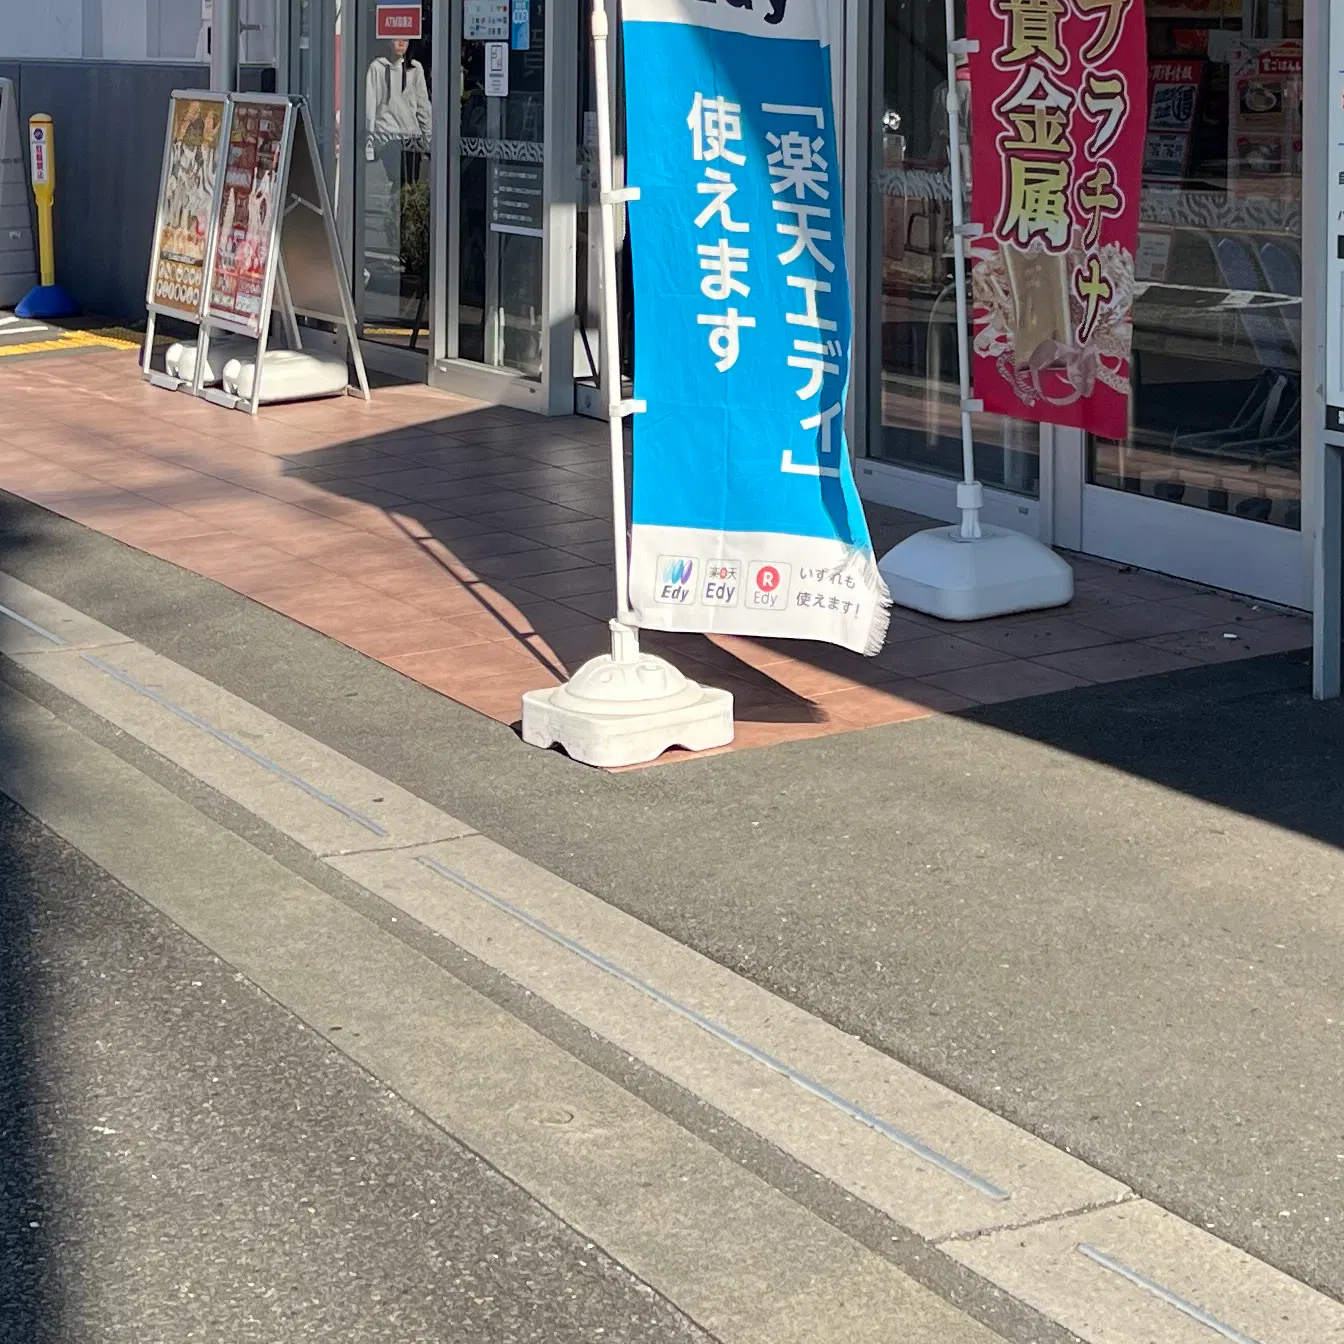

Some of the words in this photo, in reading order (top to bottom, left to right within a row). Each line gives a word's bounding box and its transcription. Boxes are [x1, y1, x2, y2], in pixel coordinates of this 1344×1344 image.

[685, 92, 757, 373] 使えます
[761, 101, 844, 477] 「楽天エディ」
[799, 567, 856, 589] いずれも
[661, 584, 690, 603] Edy
[706, 582, 735, 604] Edy
[754, 591, 778, 607] Edy
[796, 590, 860, 619] 使えます!
